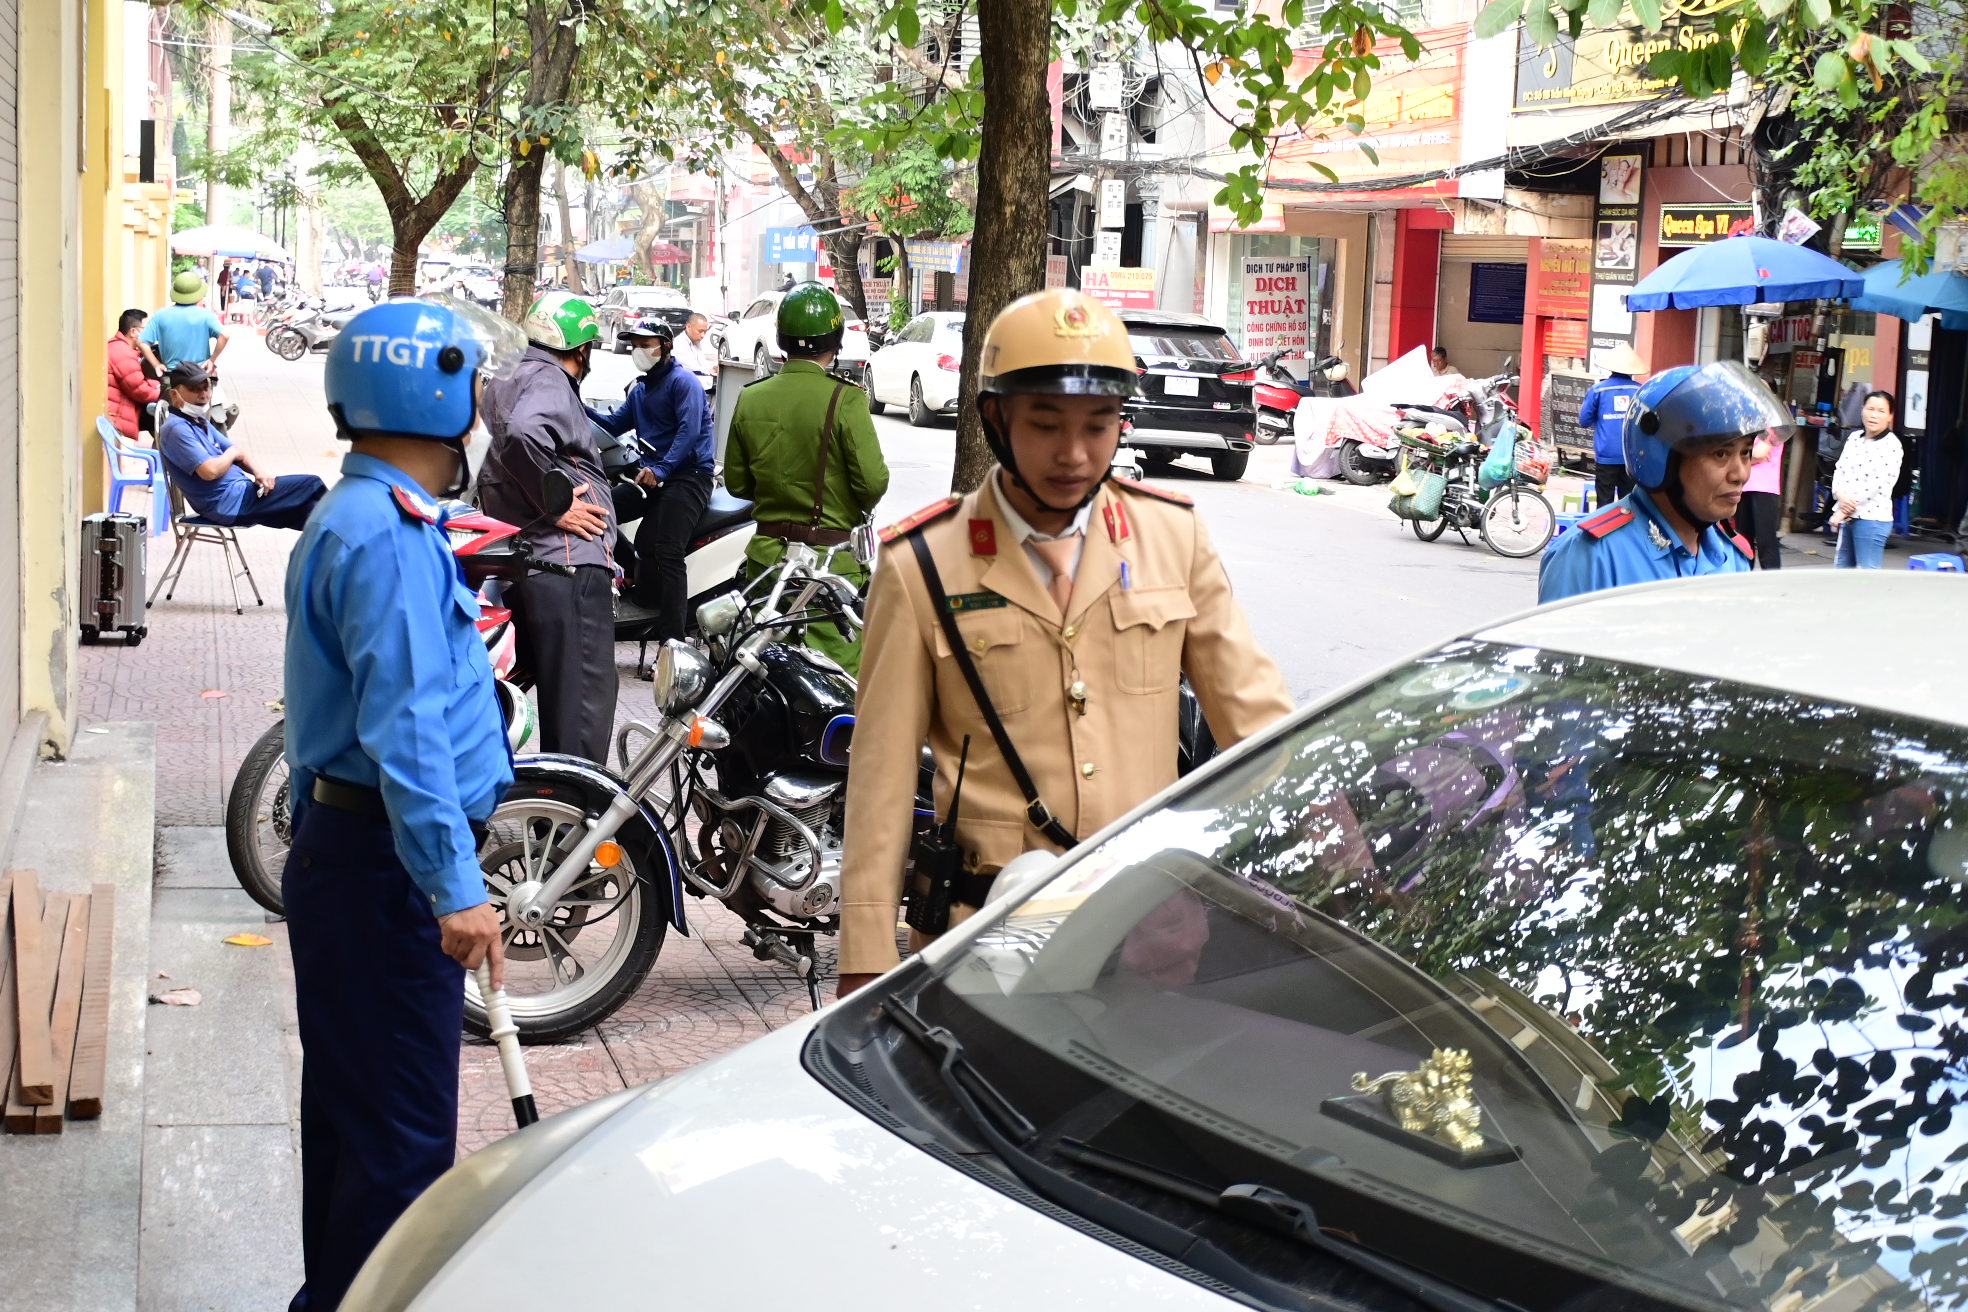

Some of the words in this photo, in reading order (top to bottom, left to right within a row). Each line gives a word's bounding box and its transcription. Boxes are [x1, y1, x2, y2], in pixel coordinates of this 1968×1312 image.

[1664, 214, 1694, 238] Queen
[1695, 214, 1714, 239] Spa
[1246, 263, 1263, 275] DỊCH
[1265, 262, 1274, 274] TƯ
[1276, 260, 1294, 273] PHÁP
[1255, 276, 1298, 297] DỊCH
[1246, 295, 1307, 318] THUẬT
[1246, 321, 1264, 333] CÔNG
[1298, 321, 1307, 331] SƠ
[351, 335, 433, 369] TTGT
[1248, 337, 1264, 349] ĐỊNH
[1265, 336, 1274, 347] CƯ
